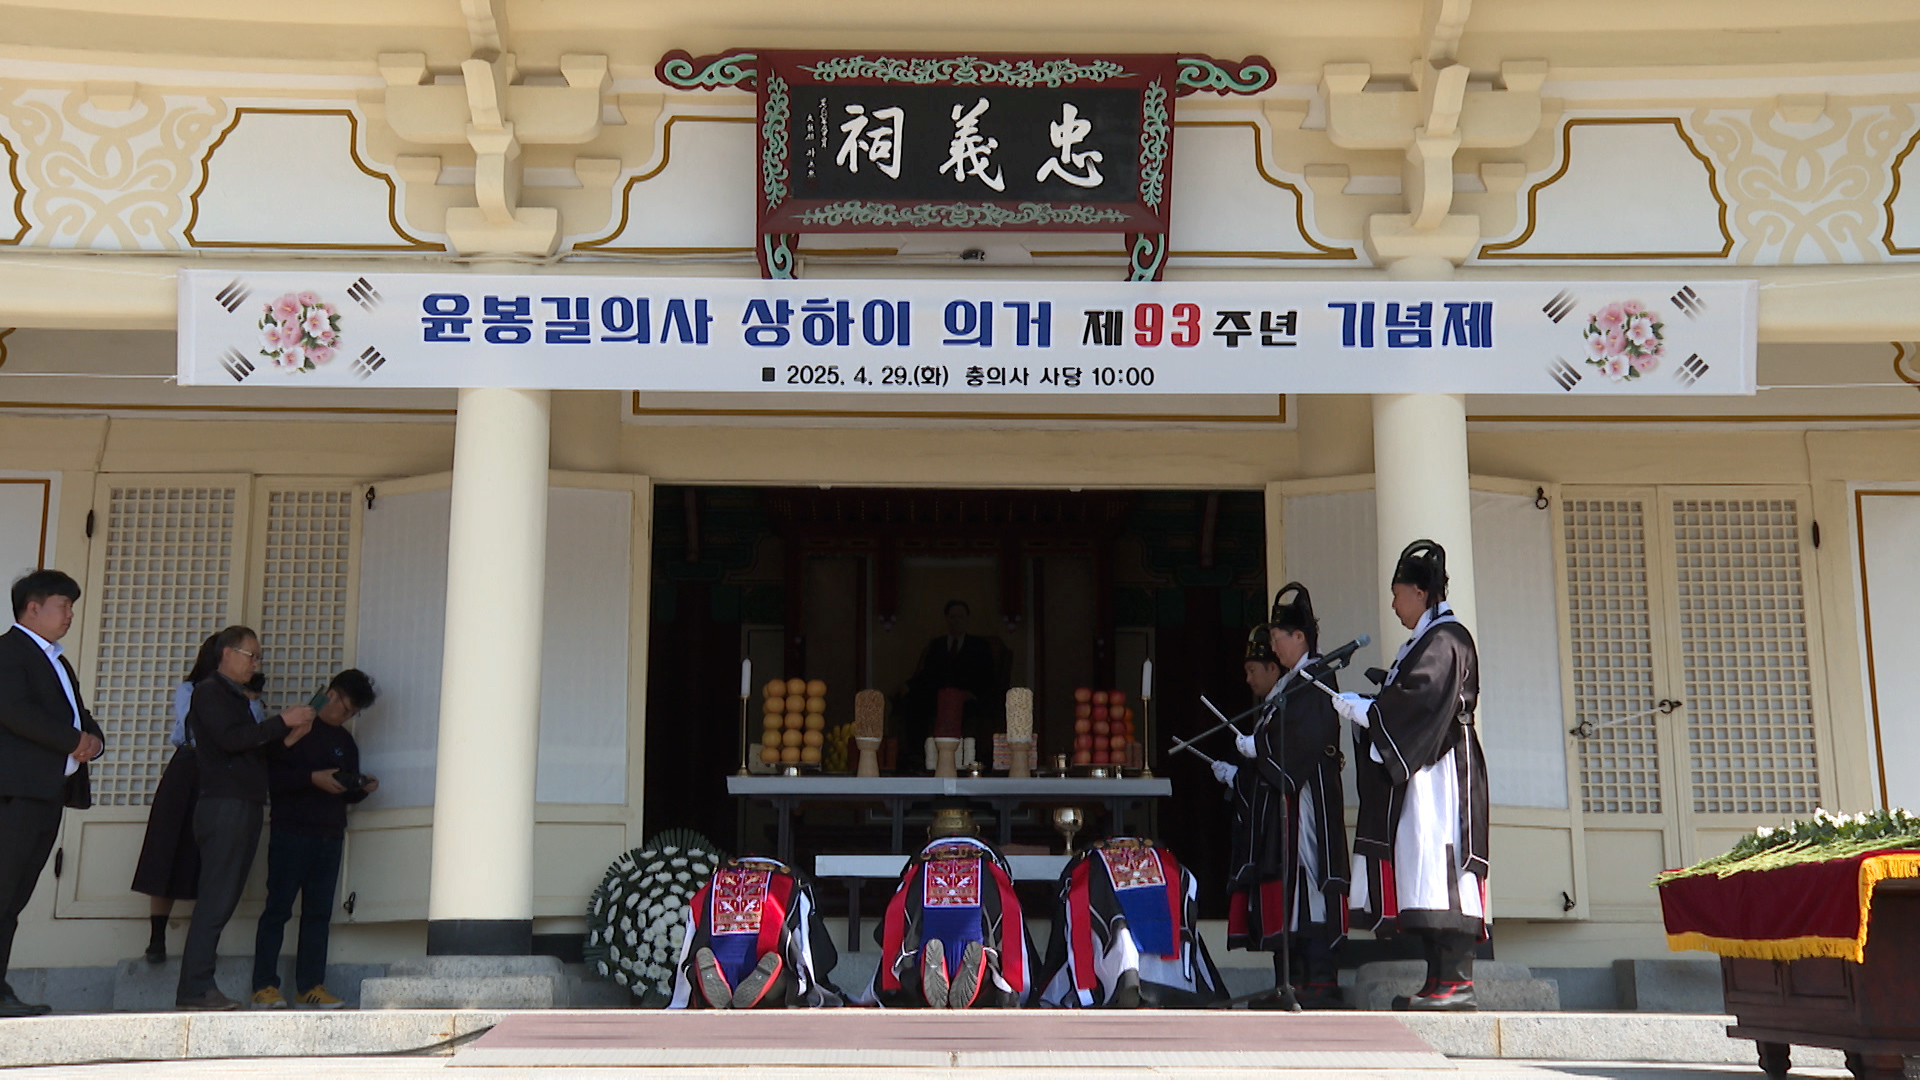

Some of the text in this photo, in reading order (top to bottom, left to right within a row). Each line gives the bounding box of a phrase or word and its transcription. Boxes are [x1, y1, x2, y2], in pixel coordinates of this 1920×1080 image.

[421, 294, 1493, 349] 윤봉길의사 상하이 의거 제93주년 기념제
[786, 365, 1155, 388] 2025. 4. 29.(화) 충의사 사당 10:00
